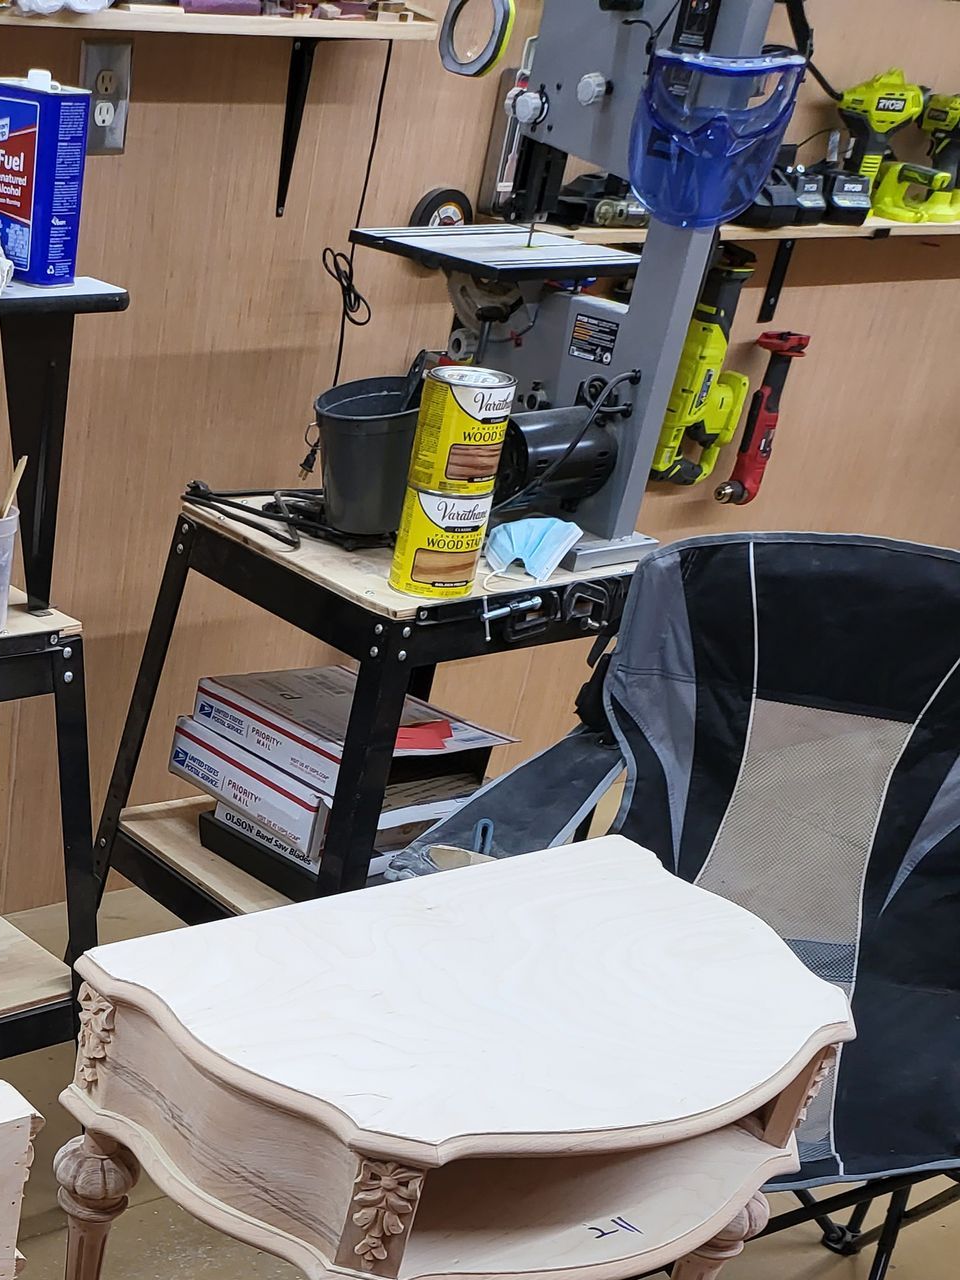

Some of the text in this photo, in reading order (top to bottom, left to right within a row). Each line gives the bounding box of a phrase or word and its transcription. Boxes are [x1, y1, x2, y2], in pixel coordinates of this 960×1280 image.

[877, 99, 905, 110] RYOBI
[463, 431, 497, 442] WOOD
[427, 537, 463, 549] WOOD
[211, 715, 228, 729] POSTAL
[214, 706, 244, 726] UNITED STATES
[256, 739, 272, 751] MAIL
[185, 763, 202, 777] POSTAL
[188, 754, 220, 777] UNITED STATES
[232, 792, 249, 807] MAIL
[225, 812, 312, 866] OLSON Band Saw Blades
